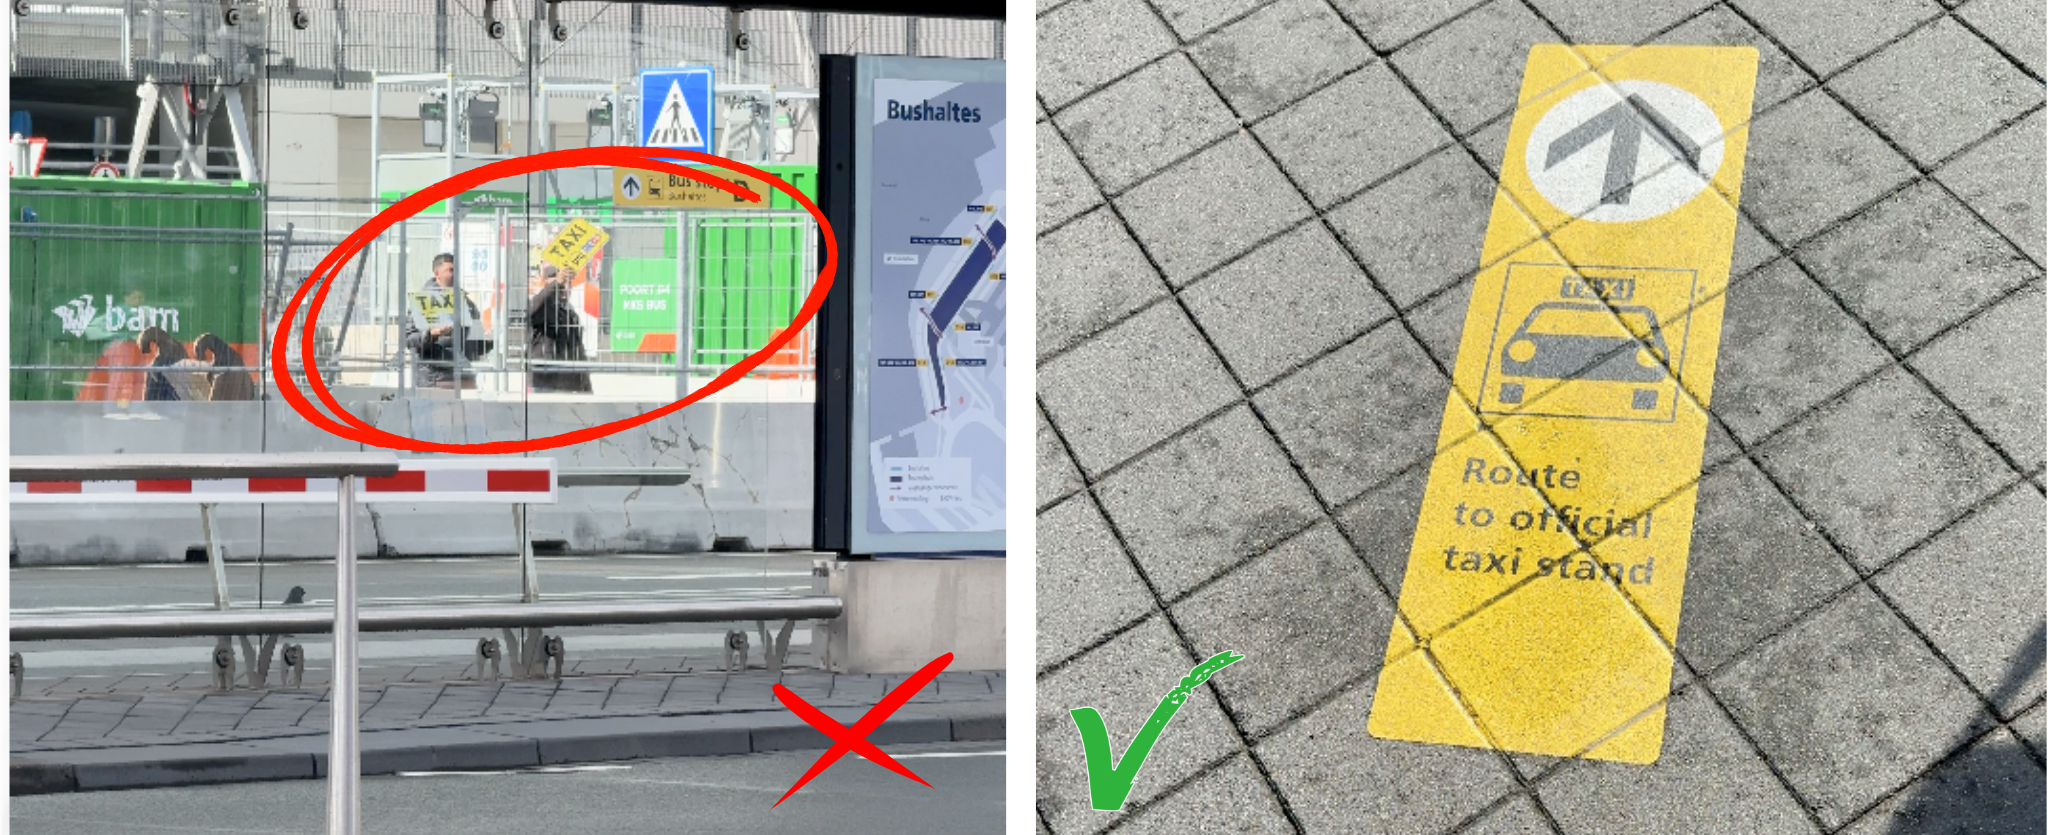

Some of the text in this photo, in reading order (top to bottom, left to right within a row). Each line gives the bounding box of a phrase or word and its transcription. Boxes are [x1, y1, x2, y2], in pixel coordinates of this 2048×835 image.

[887, 99, 981, 123] Bushaltes
[669, 173, 691, 187] Bus
[549, 224, 587, 257] TAXI
[620, 285, 654, 295] POORT
[1565, 279, 1630, 299] TAXI
[106, 294, 179, 333] bam
[415, 294, 454, 310] TAX
[646, 300, 666, 310] BUS
[1463, 456, 1581, 489] Route
[1455, 501, 1653, 538] to official
[1444, 546, 1655, 585] taxi stand
